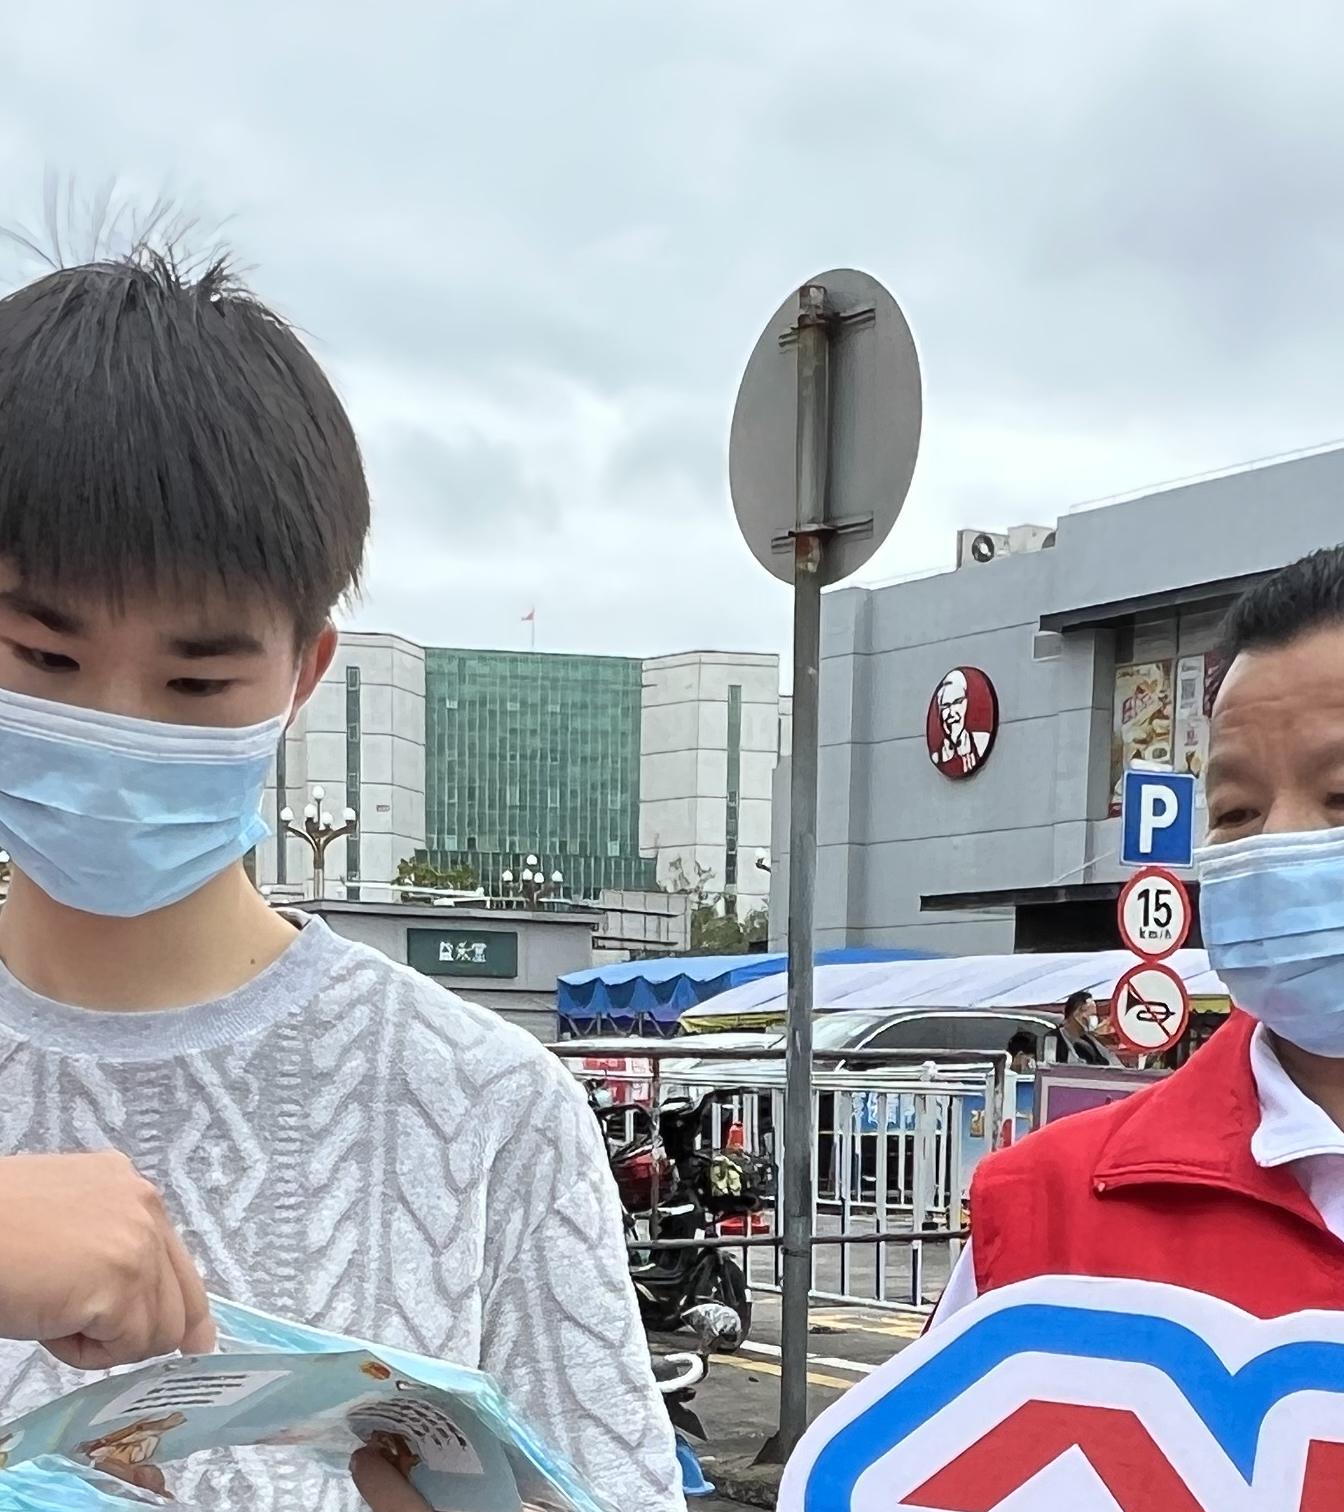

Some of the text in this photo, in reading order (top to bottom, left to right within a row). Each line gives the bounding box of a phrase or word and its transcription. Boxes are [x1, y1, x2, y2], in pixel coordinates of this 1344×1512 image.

[1139, 783, 1179, 854] P
[1137, 888, 1173, 928] 15
[1139, 926, 1172, 940] km/h
